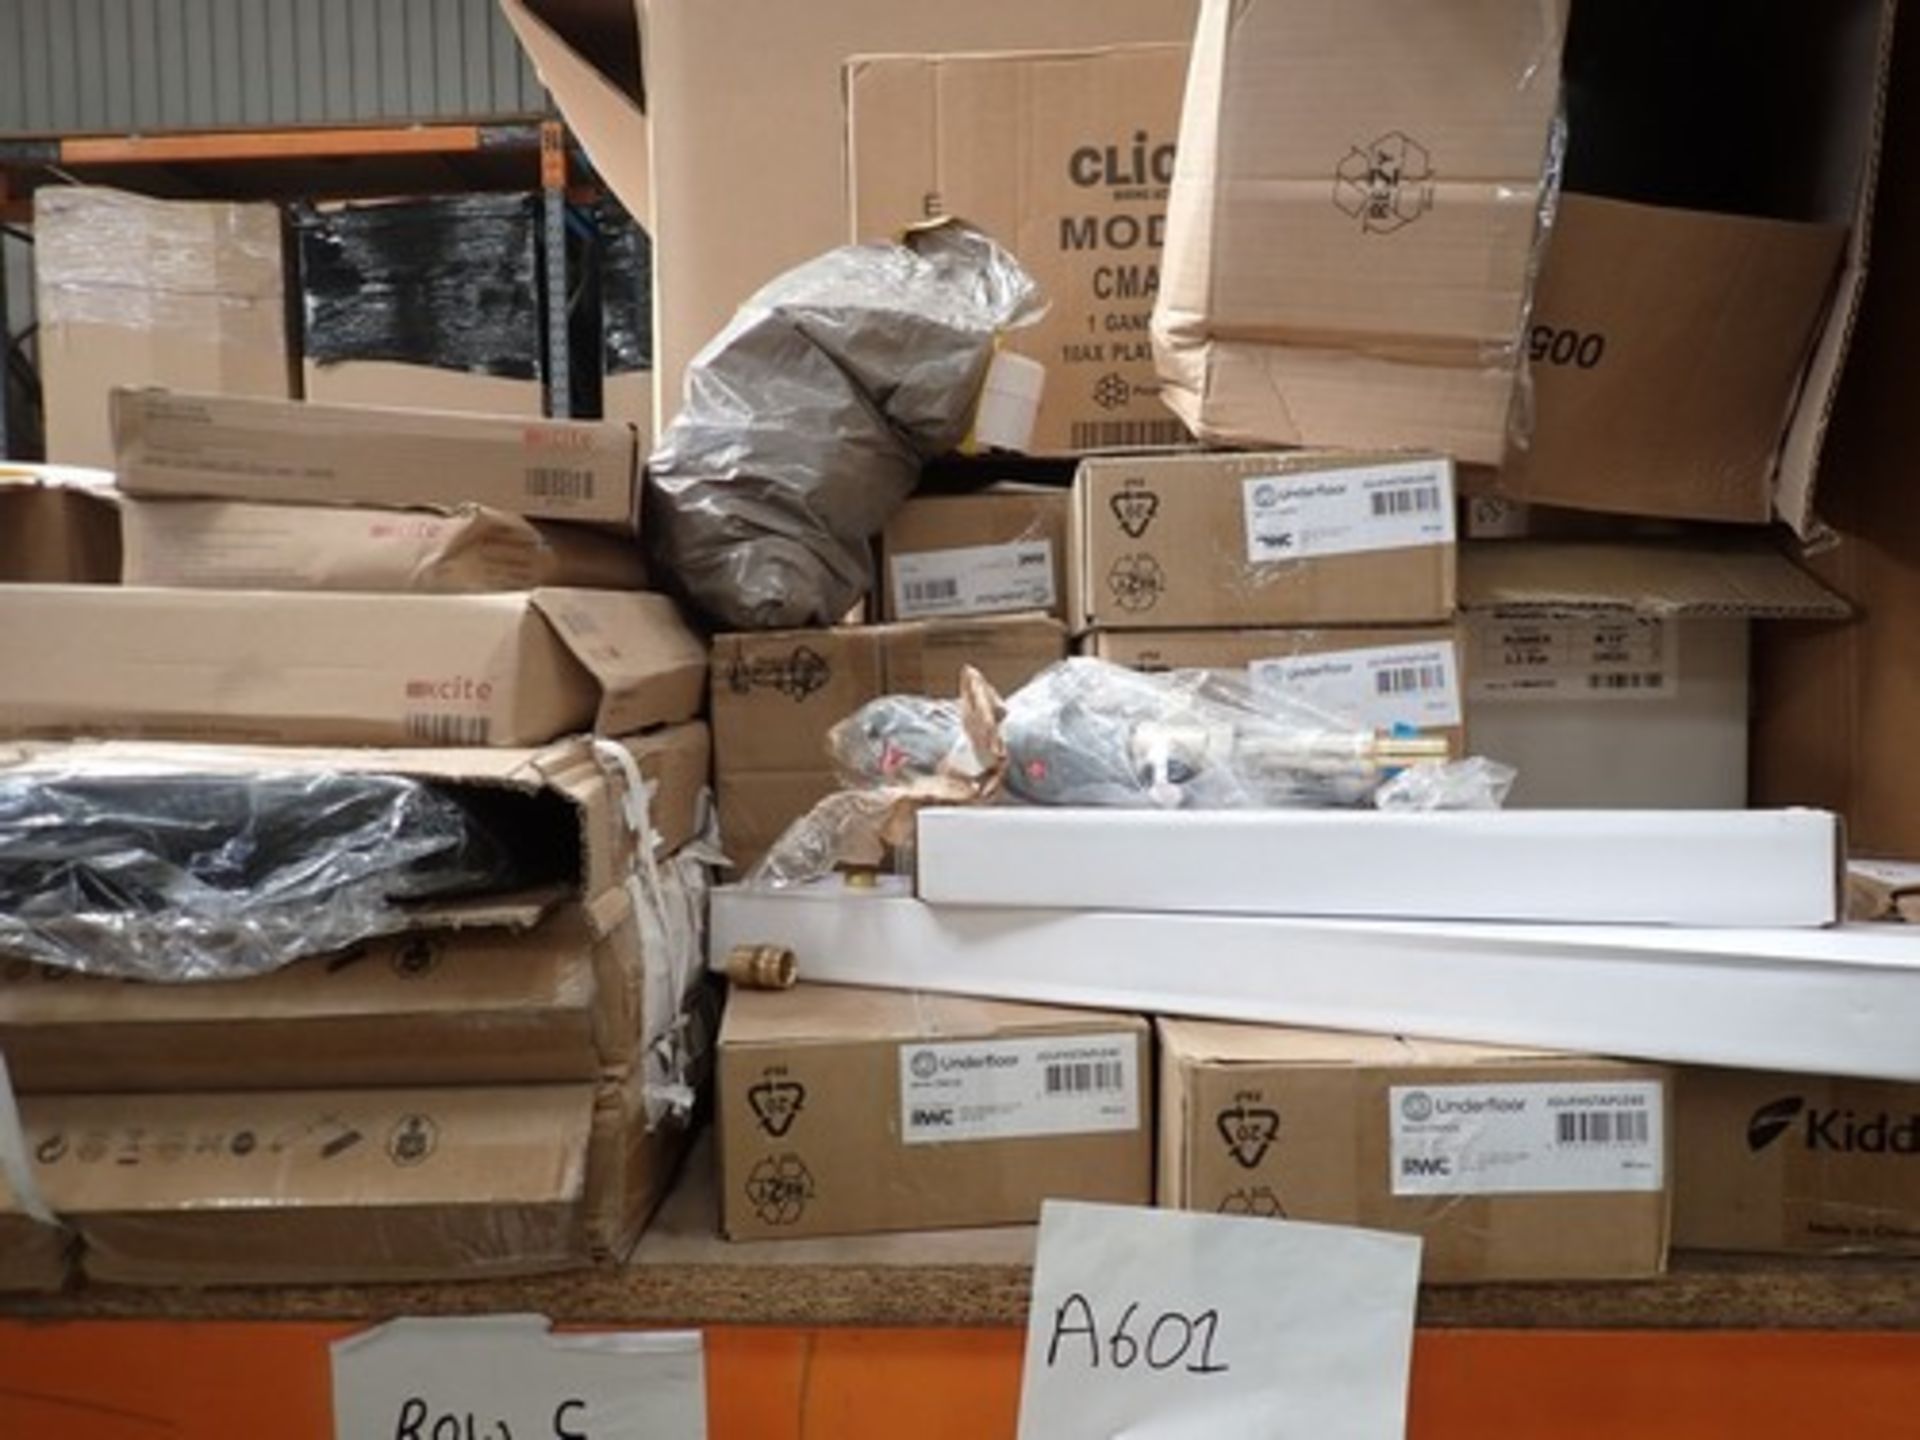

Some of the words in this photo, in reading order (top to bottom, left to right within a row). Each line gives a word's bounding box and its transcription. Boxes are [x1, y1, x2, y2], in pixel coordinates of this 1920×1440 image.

[939, 1053, 1019, 1071] Underfloor
[1435, 1098, 1526, 1114] Underfloor
[1402, 1158, 1452, 1176] RWC
[1047, 1292, 1229, 1373] A601
